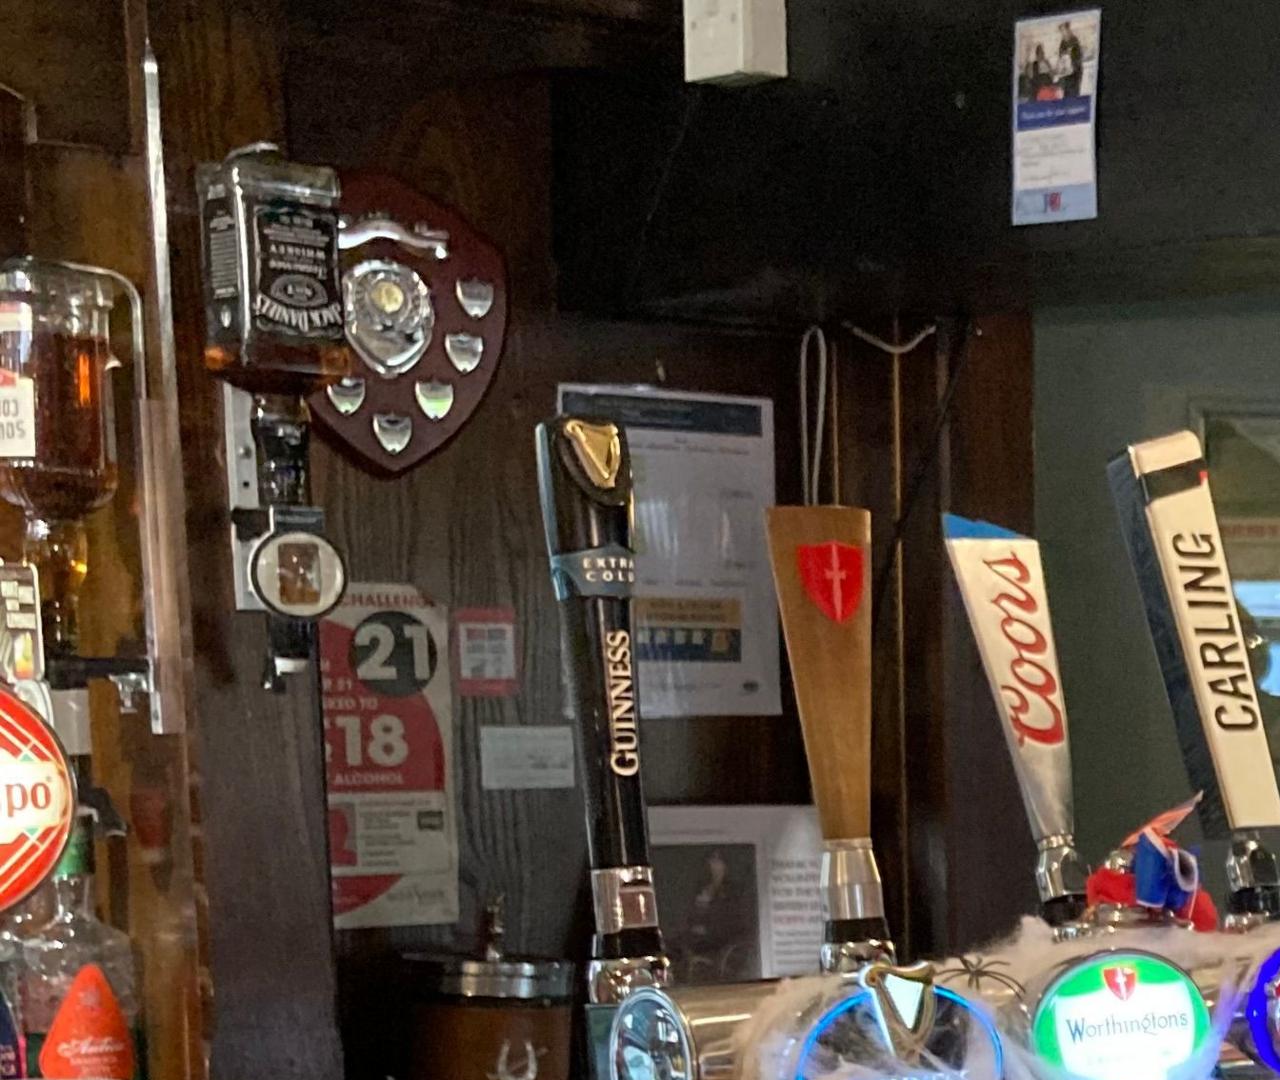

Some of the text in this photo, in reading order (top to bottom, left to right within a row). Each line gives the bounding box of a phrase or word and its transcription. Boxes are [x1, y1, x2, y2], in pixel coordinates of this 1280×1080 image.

[354, 621, 431, 681] 21
[982, 550, 1066, 748] Coors
[1172, 532, 1259, 732] CARLING
[335, 714, 409, 768] 18
[607, 629, 639, 778] GUINNESS
[1066, 1010, 1189, 1045] Worthington's
